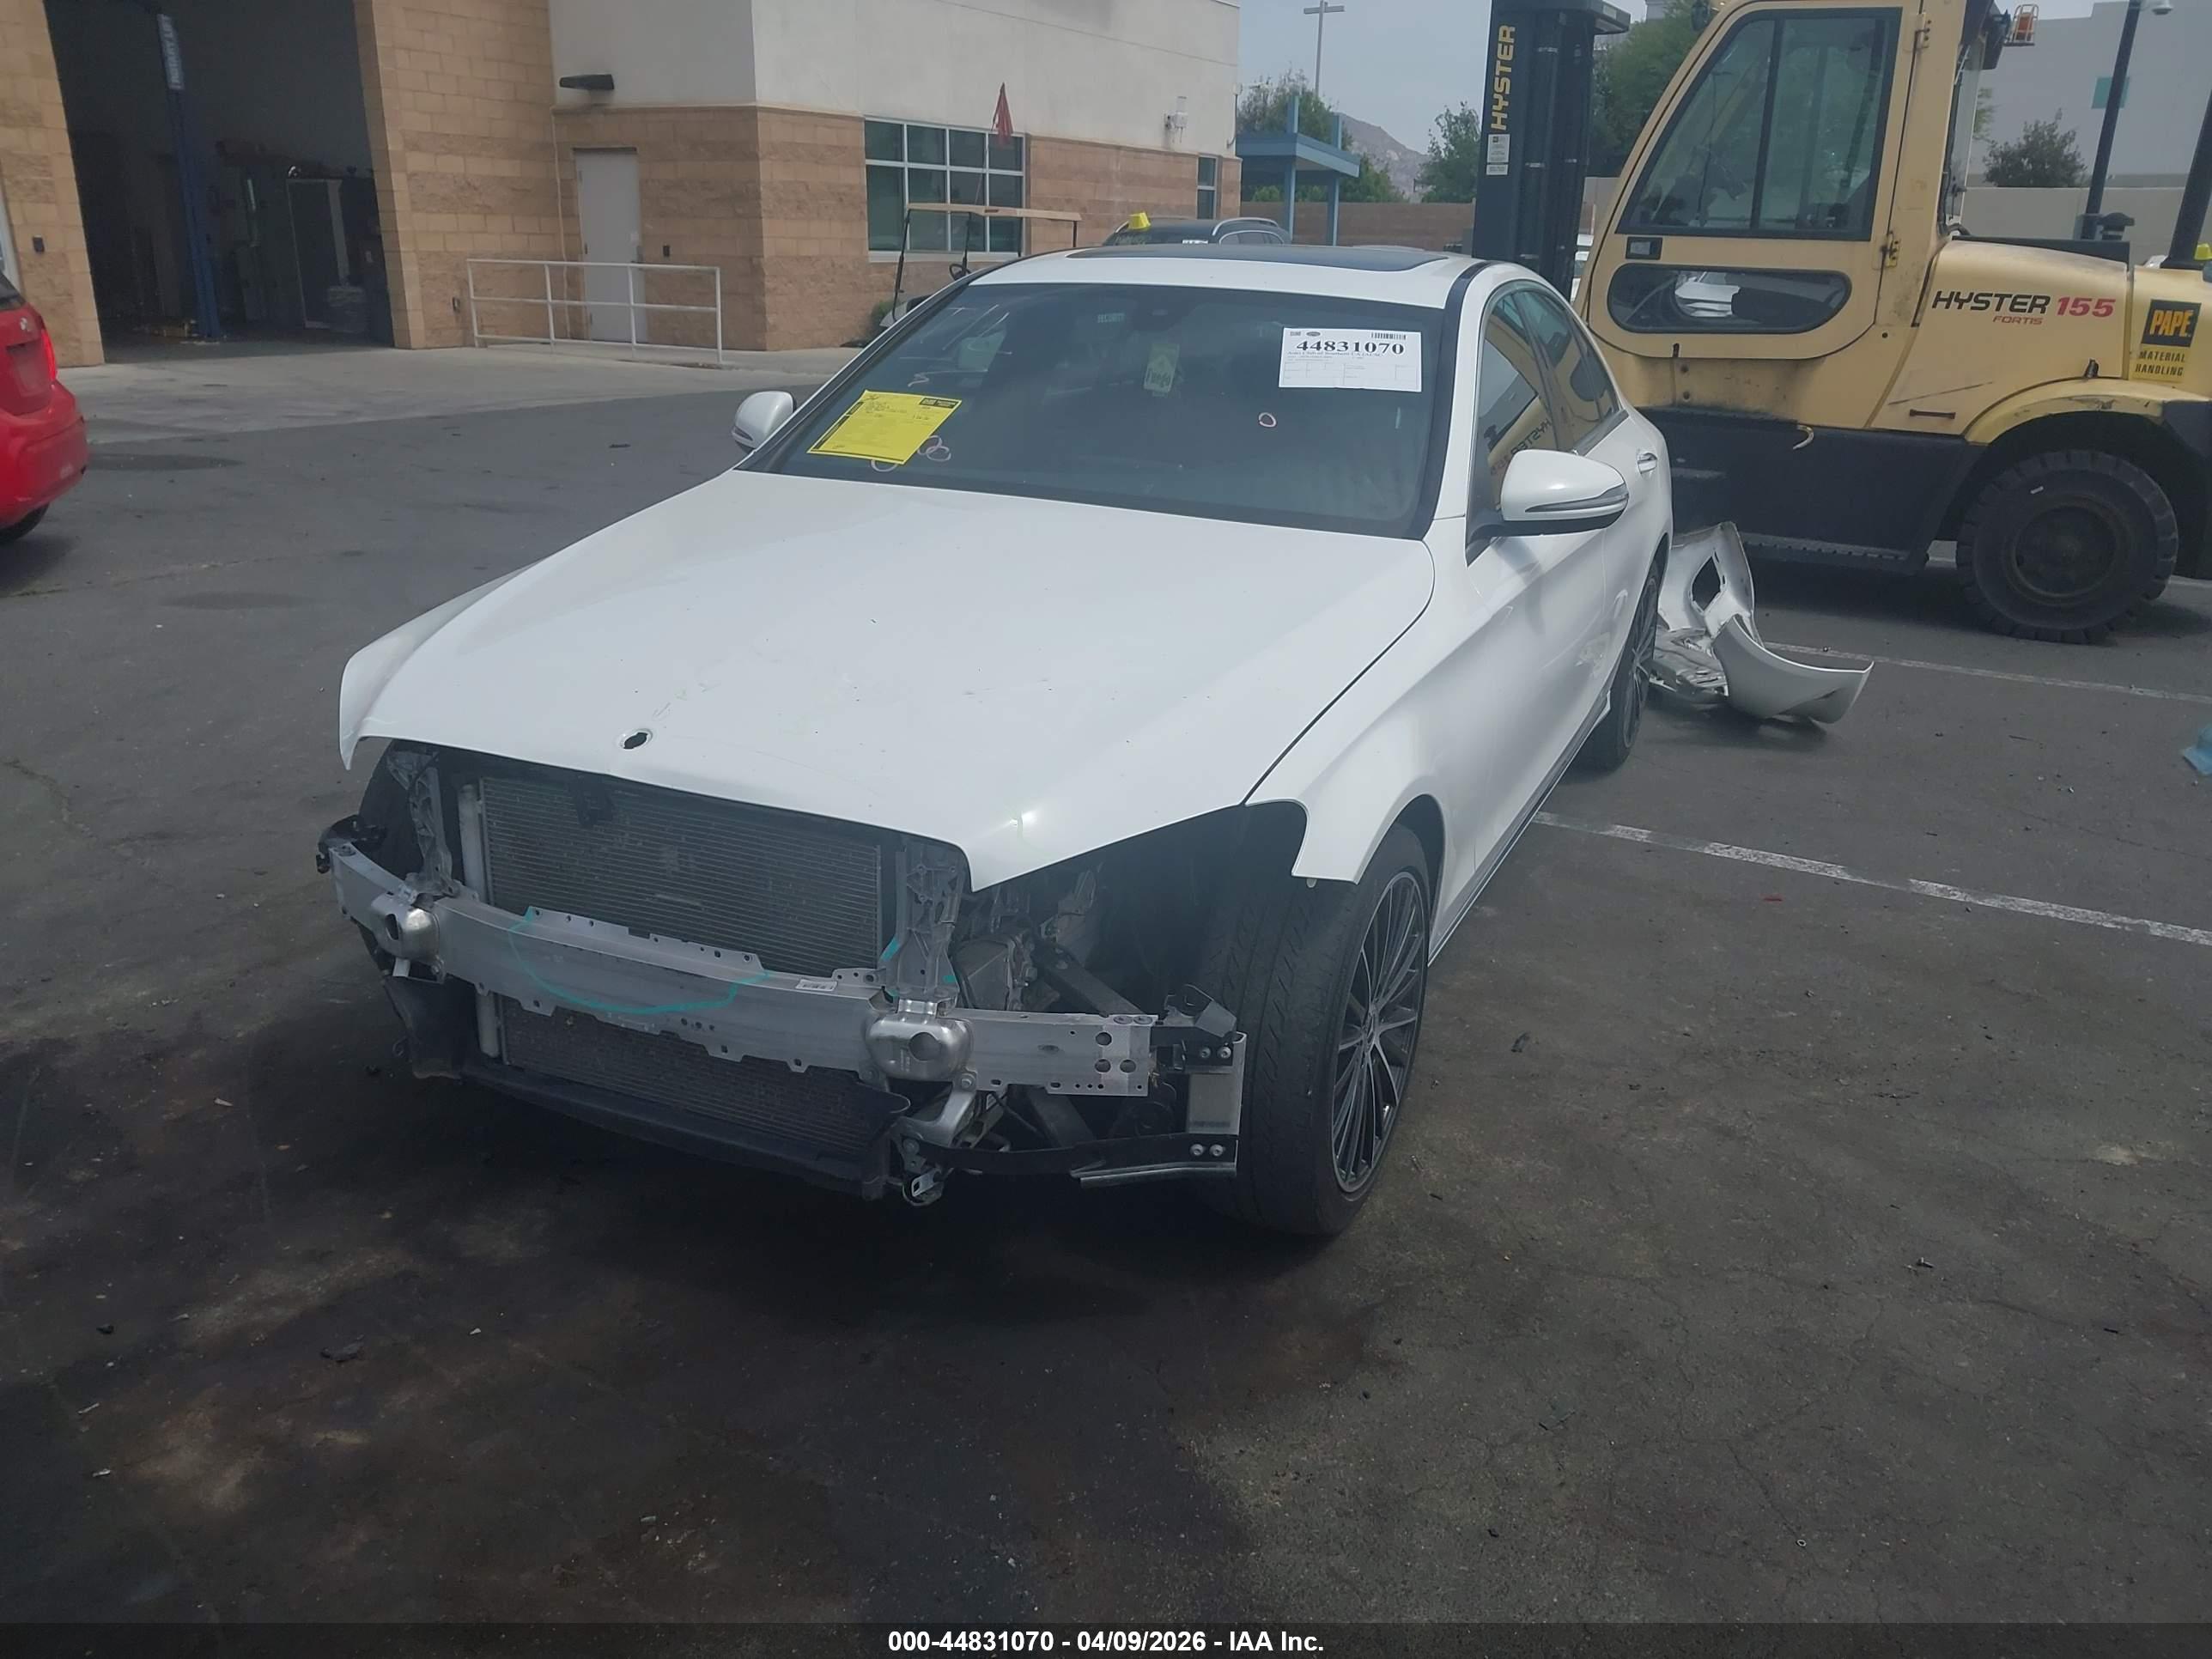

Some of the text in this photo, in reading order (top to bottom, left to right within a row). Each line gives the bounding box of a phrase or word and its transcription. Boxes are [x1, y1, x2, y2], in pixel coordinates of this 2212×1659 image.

[1491, 25, 1516, 131] HYSTER
[1932, 290, 2117, 318] HYSTER 155
[1992, 315, 2044, 325] FORTIS
[1296, 340, 1404, 355] 44831070
[2139, 349, 2185, 362] MATERIAL
[2135, 363, 2184, 376] HANDLING
